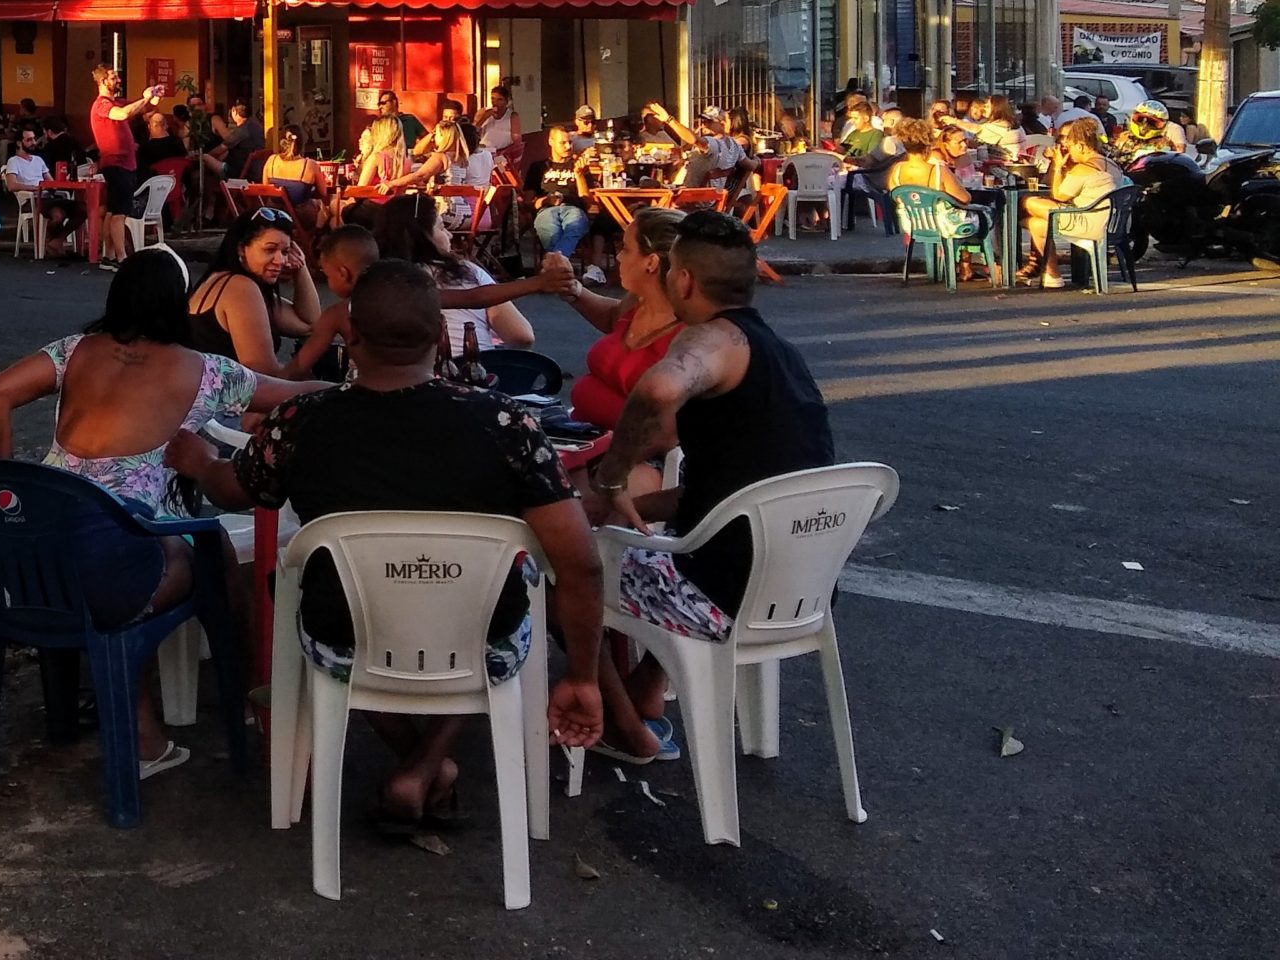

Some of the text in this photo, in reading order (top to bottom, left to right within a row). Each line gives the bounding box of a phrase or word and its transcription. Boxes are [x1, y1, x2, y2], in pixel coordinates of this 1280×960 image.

[372, 49, 385, 57] THIS
[371, 57, 389, 66] BUD'S
[372, 66, 383, 74] FOR
